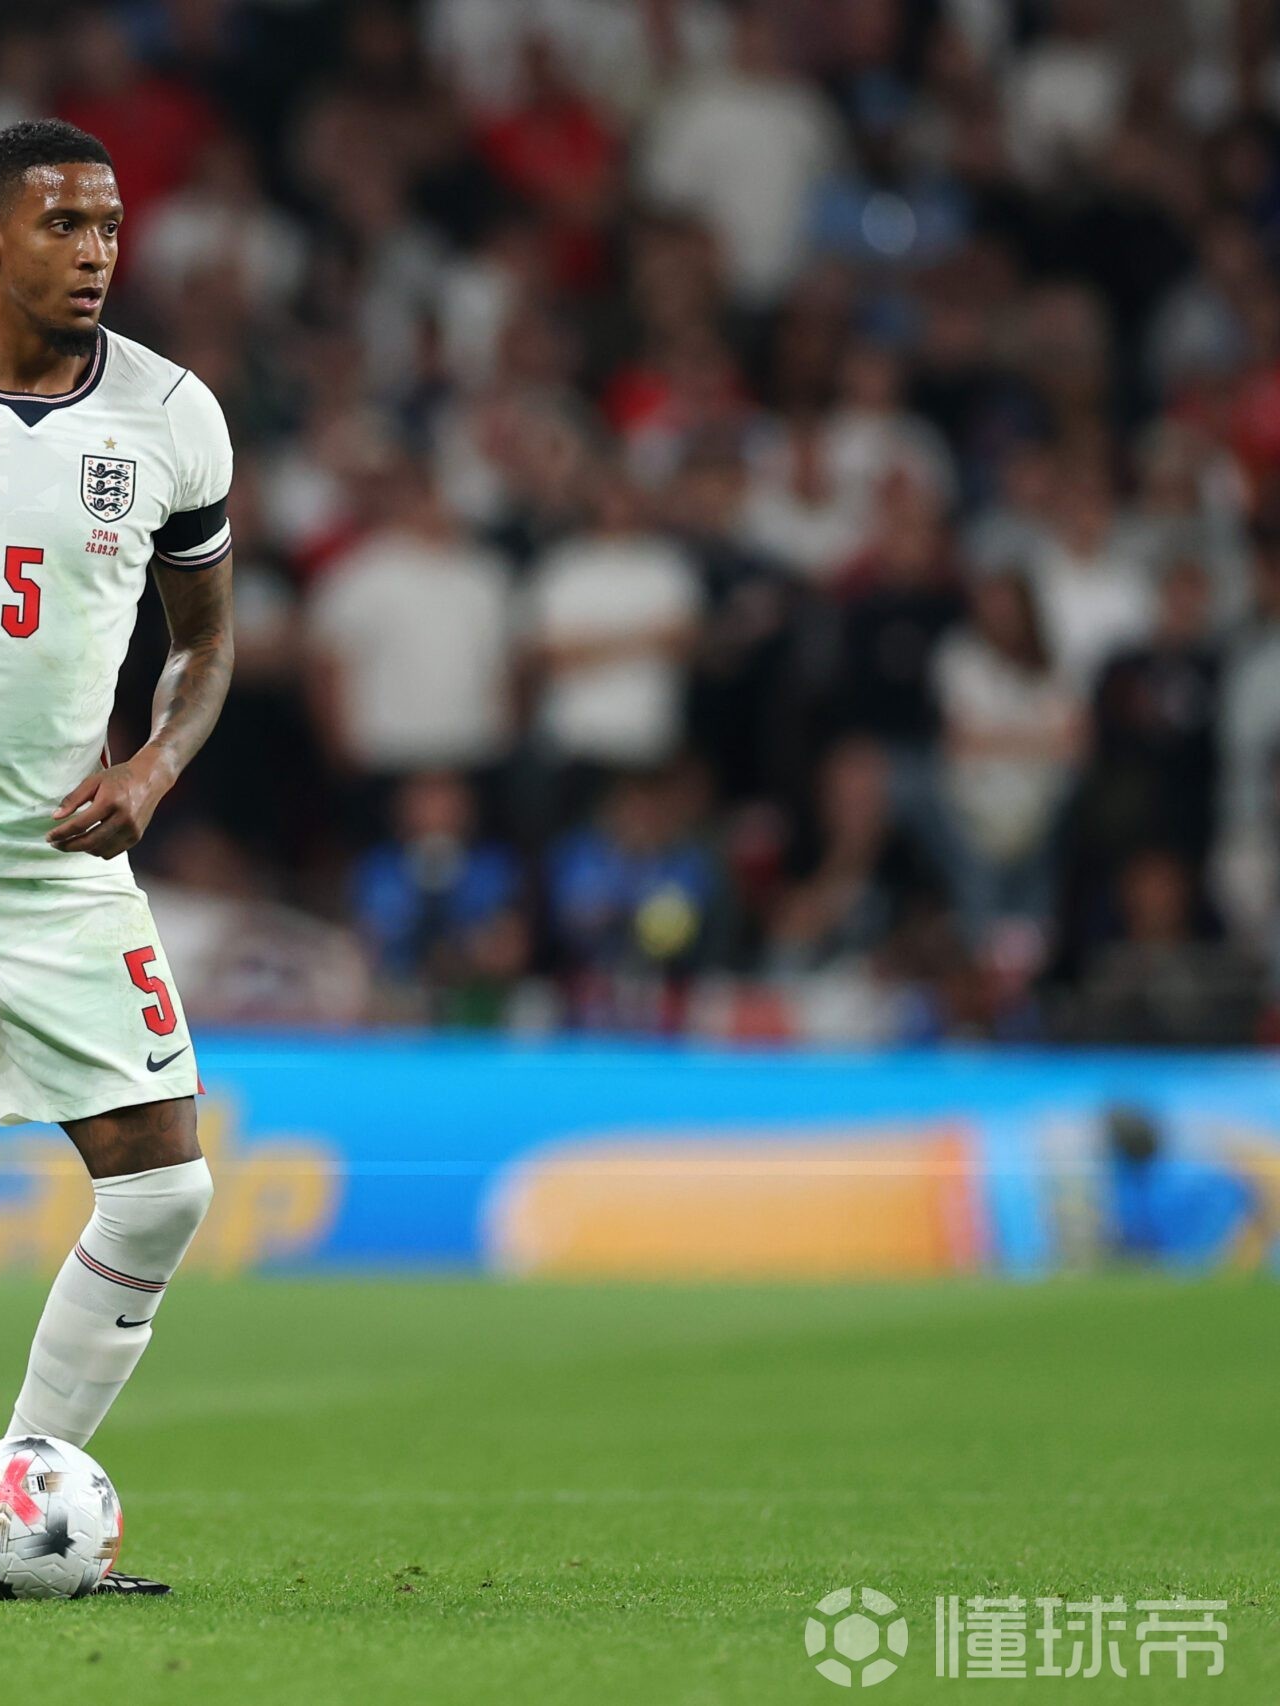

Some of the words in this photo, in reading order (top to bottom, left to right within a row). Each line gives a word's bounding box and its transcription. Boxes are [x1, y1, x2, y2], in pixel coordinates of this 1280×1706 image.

[91, 529, 118, 543] SPAIN
[1, 545, 44, 638] 5
[123, 945, 177, 1036] 5
